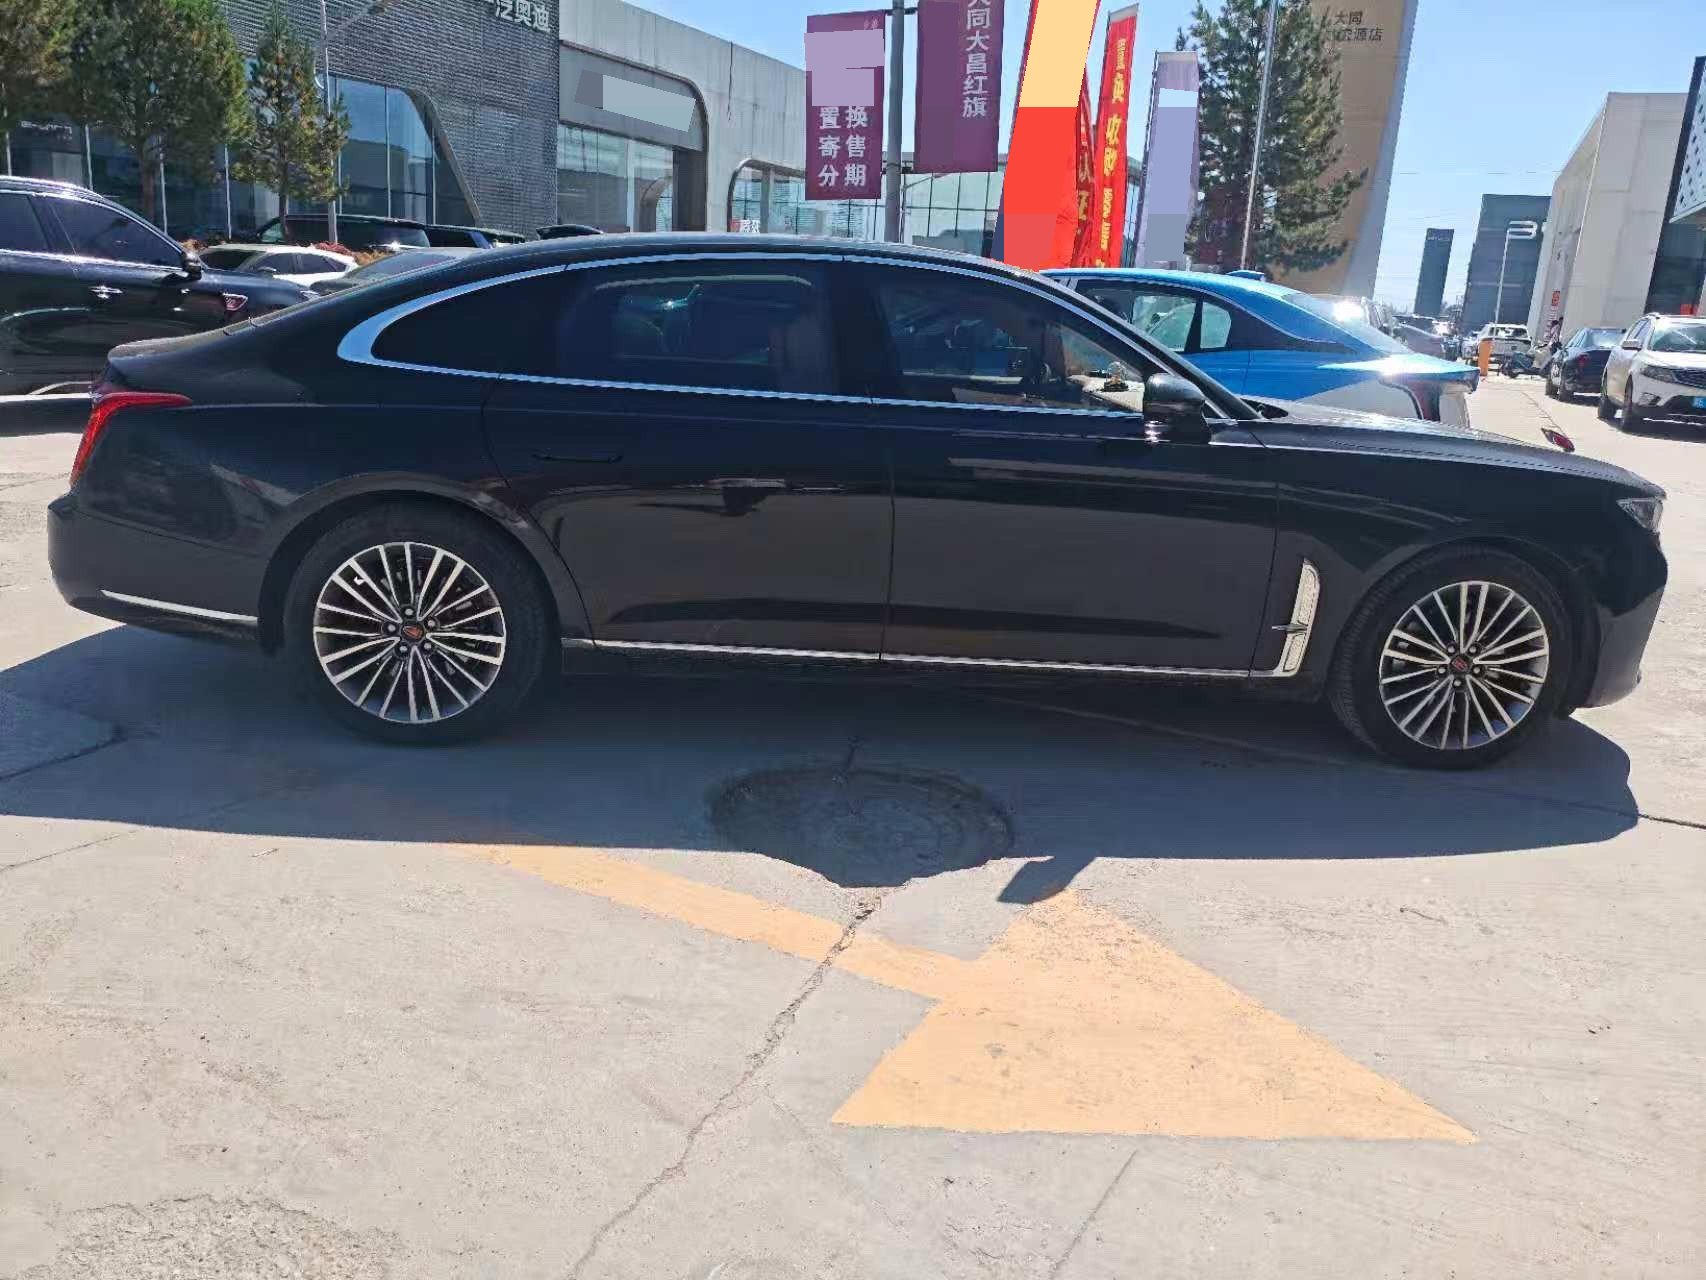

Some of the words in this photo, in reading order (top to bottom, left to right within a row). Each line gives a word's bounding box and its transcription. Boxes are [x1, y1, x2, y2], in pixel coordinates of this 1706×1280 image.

[1333, 11, 1363, 26] 大同
[819, 106, 868, 129] 置换
[818, 134, 866, 159] 寄售
[818, 164, 867, 187] 分期
